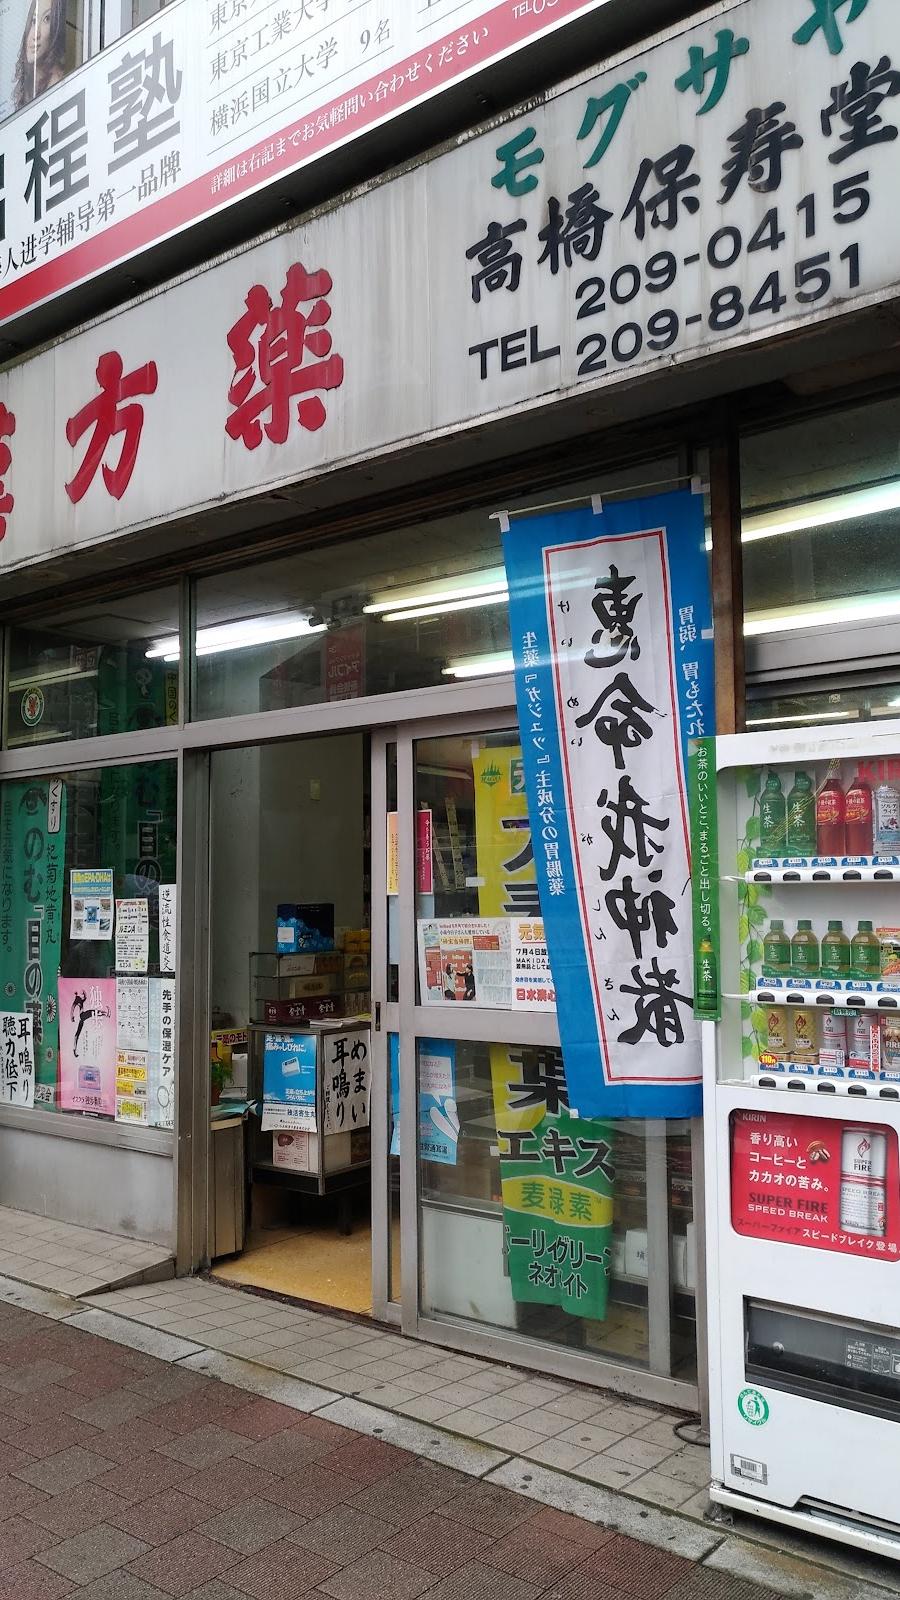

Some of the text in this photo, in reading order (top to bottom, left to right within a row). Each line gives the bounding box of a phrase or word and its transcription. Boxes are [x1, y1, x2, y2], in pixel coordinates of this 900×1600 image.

[209, 18, 391, 137] 横浜国立大学 9名
[210, 27, 489, 195] 詳細は右記までお気軽問い合わせください
[490, 0, 870, 197] モグサヤ
[0, 31, 183, 242] 程塾
[465, 55, 900, 303] 高橋保寿堂
[0, 149, 183, 281] 人进学辅导第一品牌
[575, 171, 871, 320] 209-0415
[468, 243, 861, 380] TEL 209-8451
[697, 747, 712, 932] お茶のいいとこ、まるごと出し切る。
[763, 803, 775, 829] 生茶
[793, 802, 806, 828] 生茶
[702, 959, 713, 982] 生茶
[2, 1015, 19, 1101] 聴力低下
[17, 1017, 33, 1105] 耳鳴り
[161, 989, 173, 1077] 先手の保湿ケア
[331, 1037, 351, 1127] 耳鳴り
[350, 1038, 368, 1123] めまい
[742, 1112, 767, 1122] KIRIN
[497, 1128, 616, 1183] エキス
[749, 1151, 807, 1169] コーヒーと
[749, 1170, 829, 1192] カカオの苦み。
[750, 1132, 798, 1148] 香り高い
[854, 1164, 872, 1172] FIRE
[747, 1204, 829, 1223] SPEED BREAK
[749, 1192, 793, 1208] SUPER
[795, 1199, 829, 1214] FIRE
[529, 1262, 588, 1298] ネオイト
